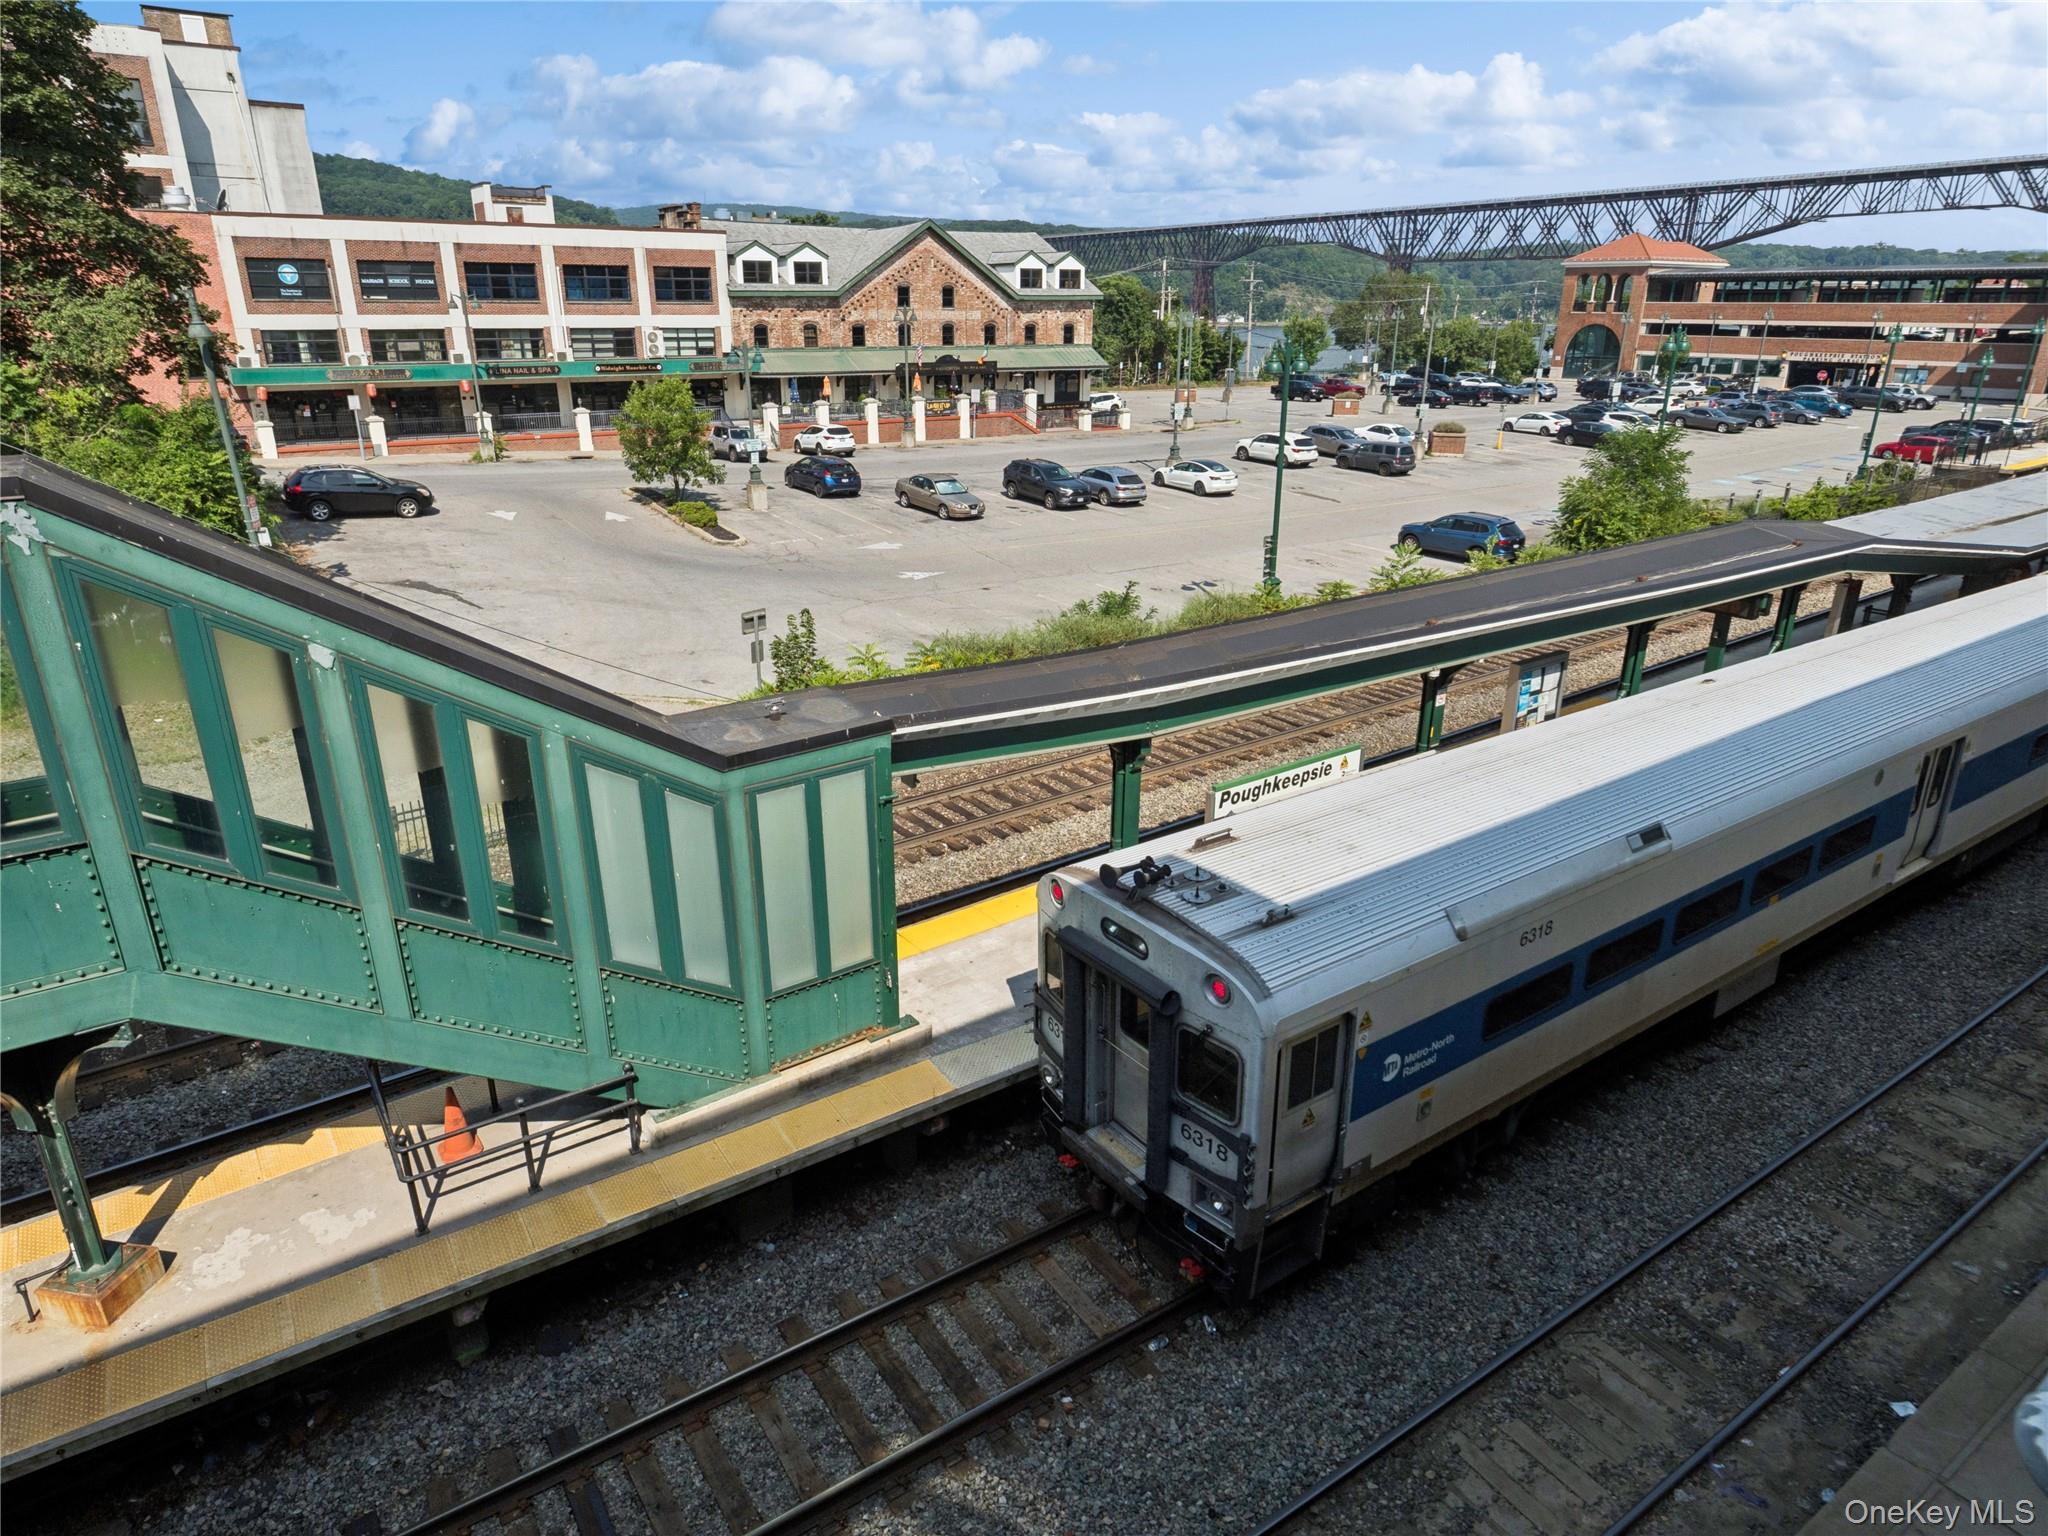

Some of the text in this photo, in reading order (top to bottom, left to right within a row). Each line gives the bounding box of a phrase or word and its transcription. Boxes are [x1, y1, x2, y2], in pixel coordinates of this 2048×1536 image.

[1218, 762, 1333, 809] Poughkeepsie
[1520, 920, 1554, 947] 6318
[1048, 1016, 1064, 1038] 63
[1404, 1034, 1455, 1065] Metro-North
[1402, 1052, 1437, 1077] Railroad
[1181, 1123, 1228, 1162] 6318
